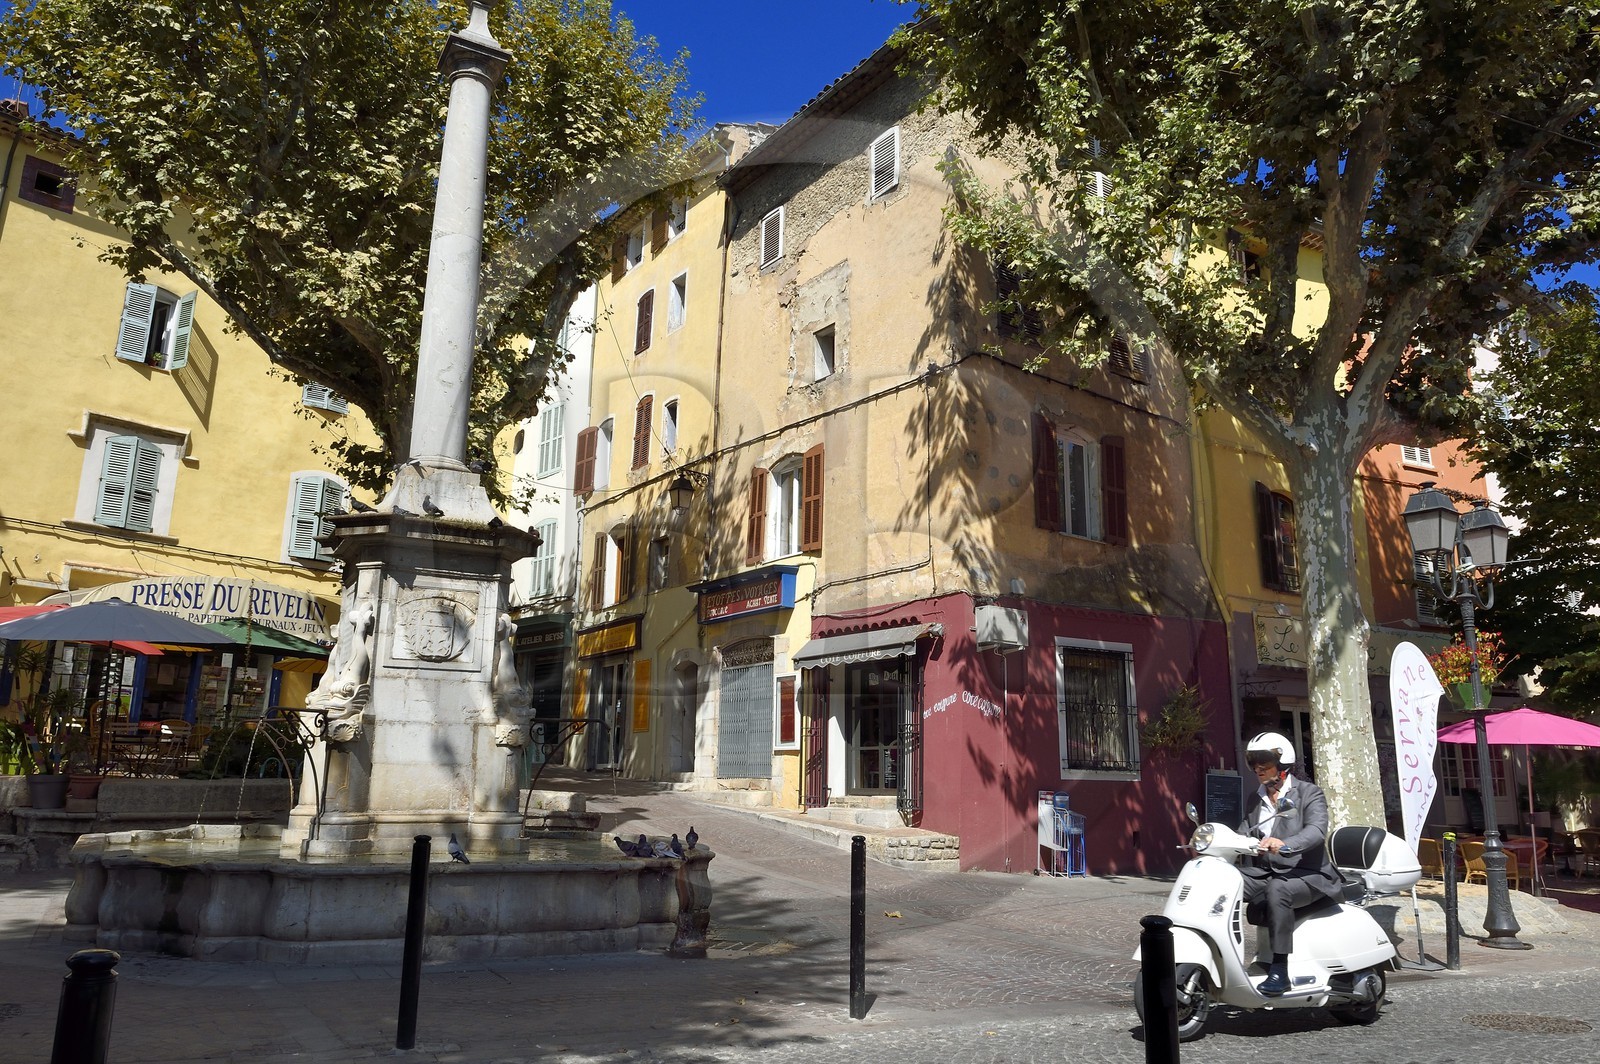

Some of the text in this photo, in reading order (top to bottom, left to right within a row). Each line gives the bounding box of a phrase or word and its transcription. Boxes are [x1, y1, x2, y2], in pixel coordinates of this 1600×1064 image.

[131, 583, 326, 621] PRESSE DU REVELIN
[188, 613, 235, 624] PAPETER
[251, 617, 297, 631] OURNAUX
[303, 623, 325, 633] JEUX
[1398, 664, 1426, 794] Servane
[1413, 703, 1436, 841] IMMOILIER
